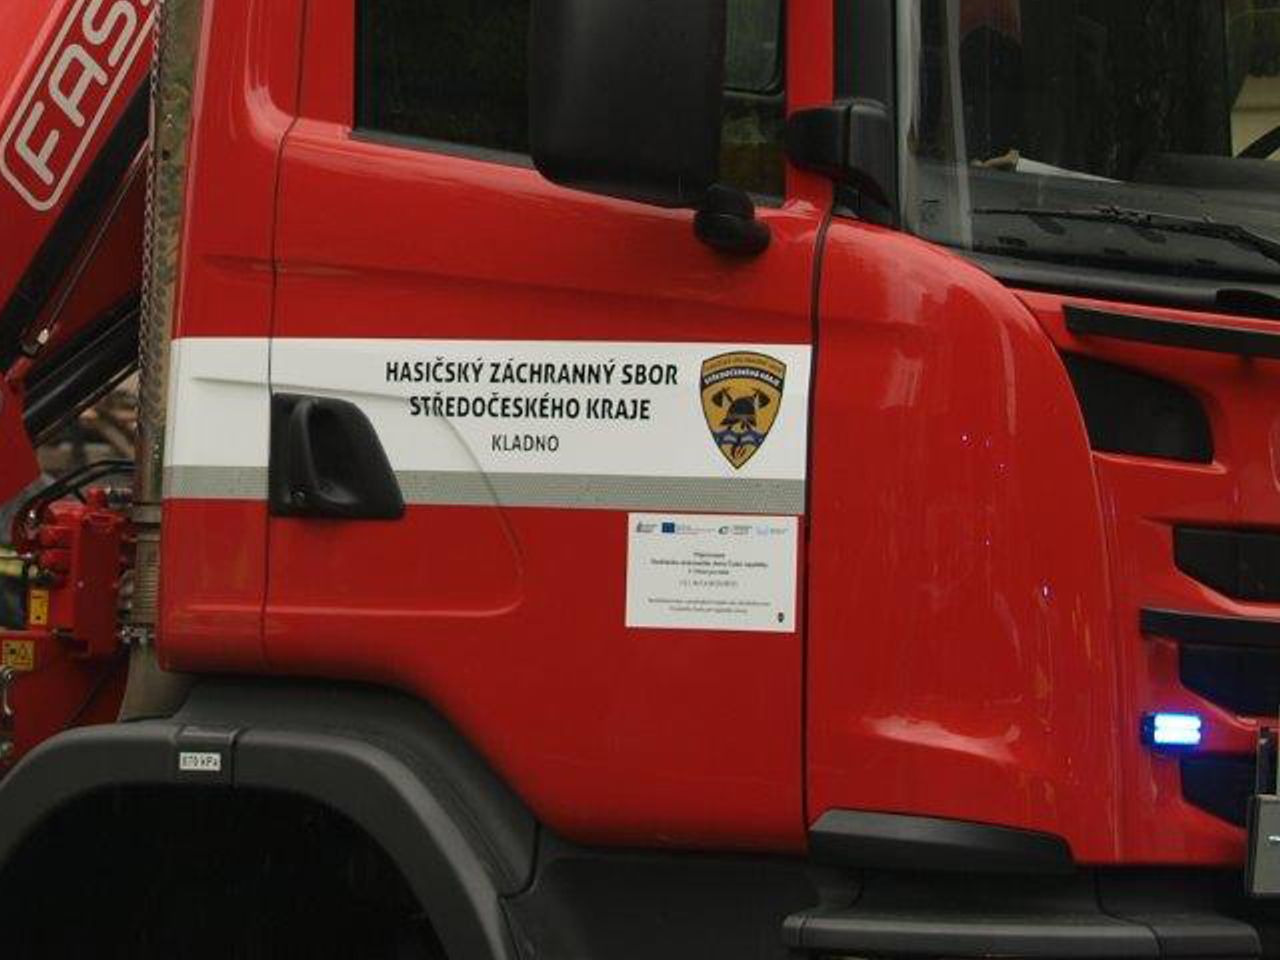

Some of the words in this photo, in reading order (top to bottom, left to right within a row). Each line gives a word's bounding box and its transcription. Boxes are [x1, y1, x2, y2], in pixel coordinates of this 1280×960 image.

[385, 356, 484, 383] HASIČSKÝ
[489, 357, 616, 385] ZÁCHRANNÝ
[621, 363, 678, 386] SBOR
[409, 391, 580, 419] STŘEDOČESKÉHO
[586, 397, 652, 420] KRAJE
[491, 434, 560, 452] KLADNO
